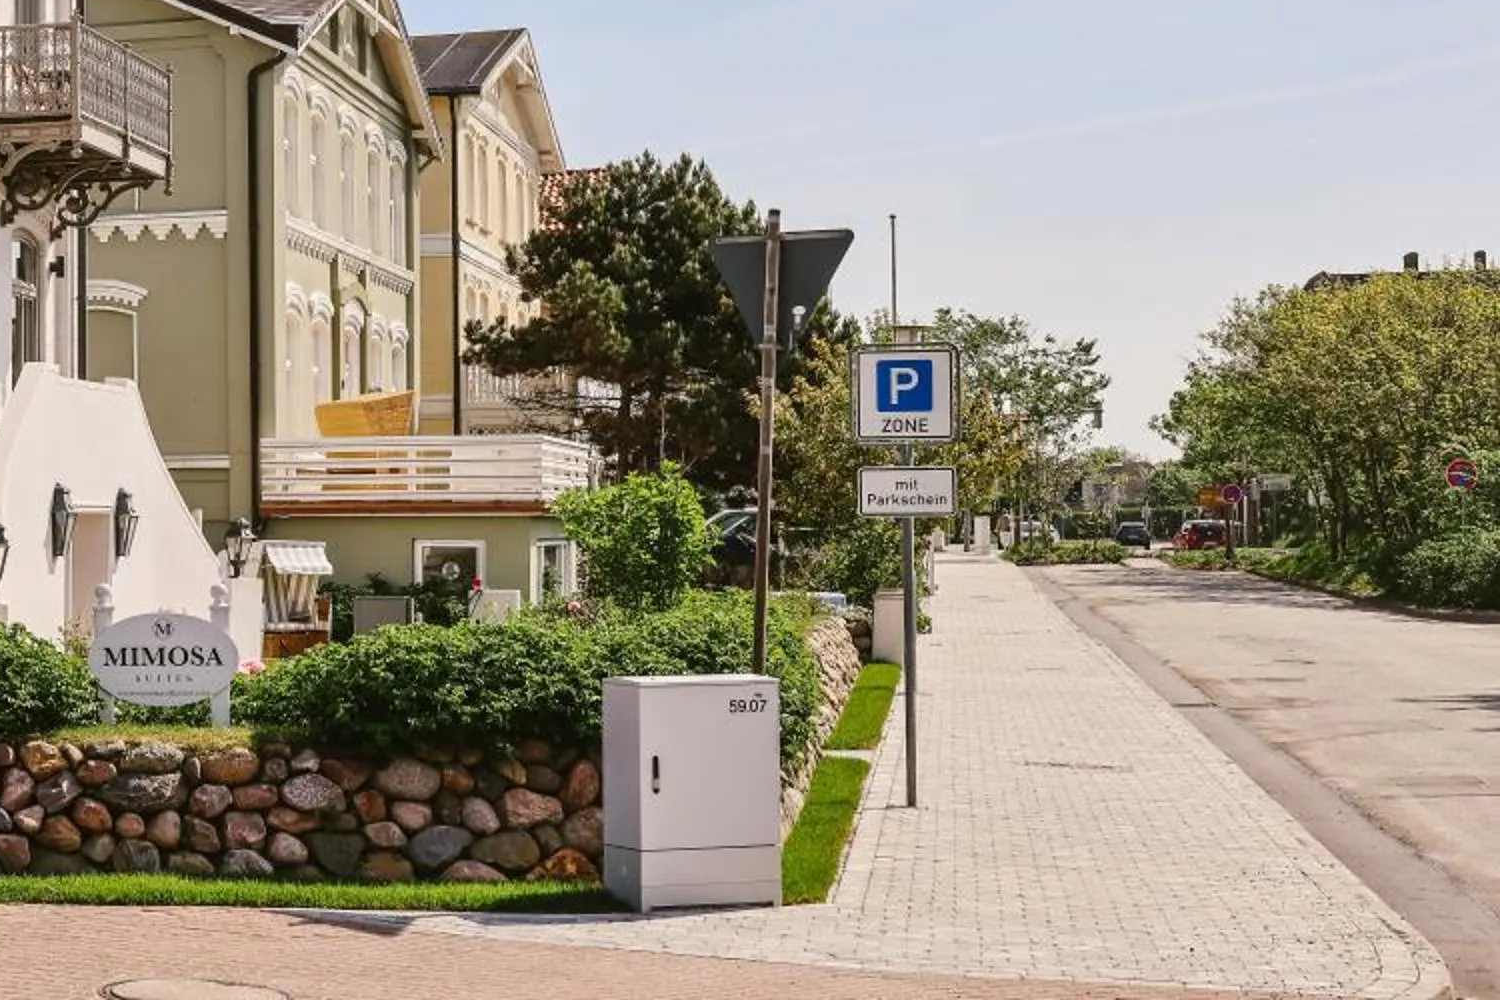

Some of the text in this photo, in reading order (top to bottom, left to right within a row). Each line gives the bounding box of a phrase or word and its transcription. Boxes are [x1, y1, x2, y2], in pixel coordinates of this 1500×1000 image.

[889, 367, 919, 405] P
[881, 417, 929, 433] ZONE
[895, 478, 918, 491] mit
[867, 493, 947, 506] Parkschein
[103, 646, 223, 667] MIMOSA
